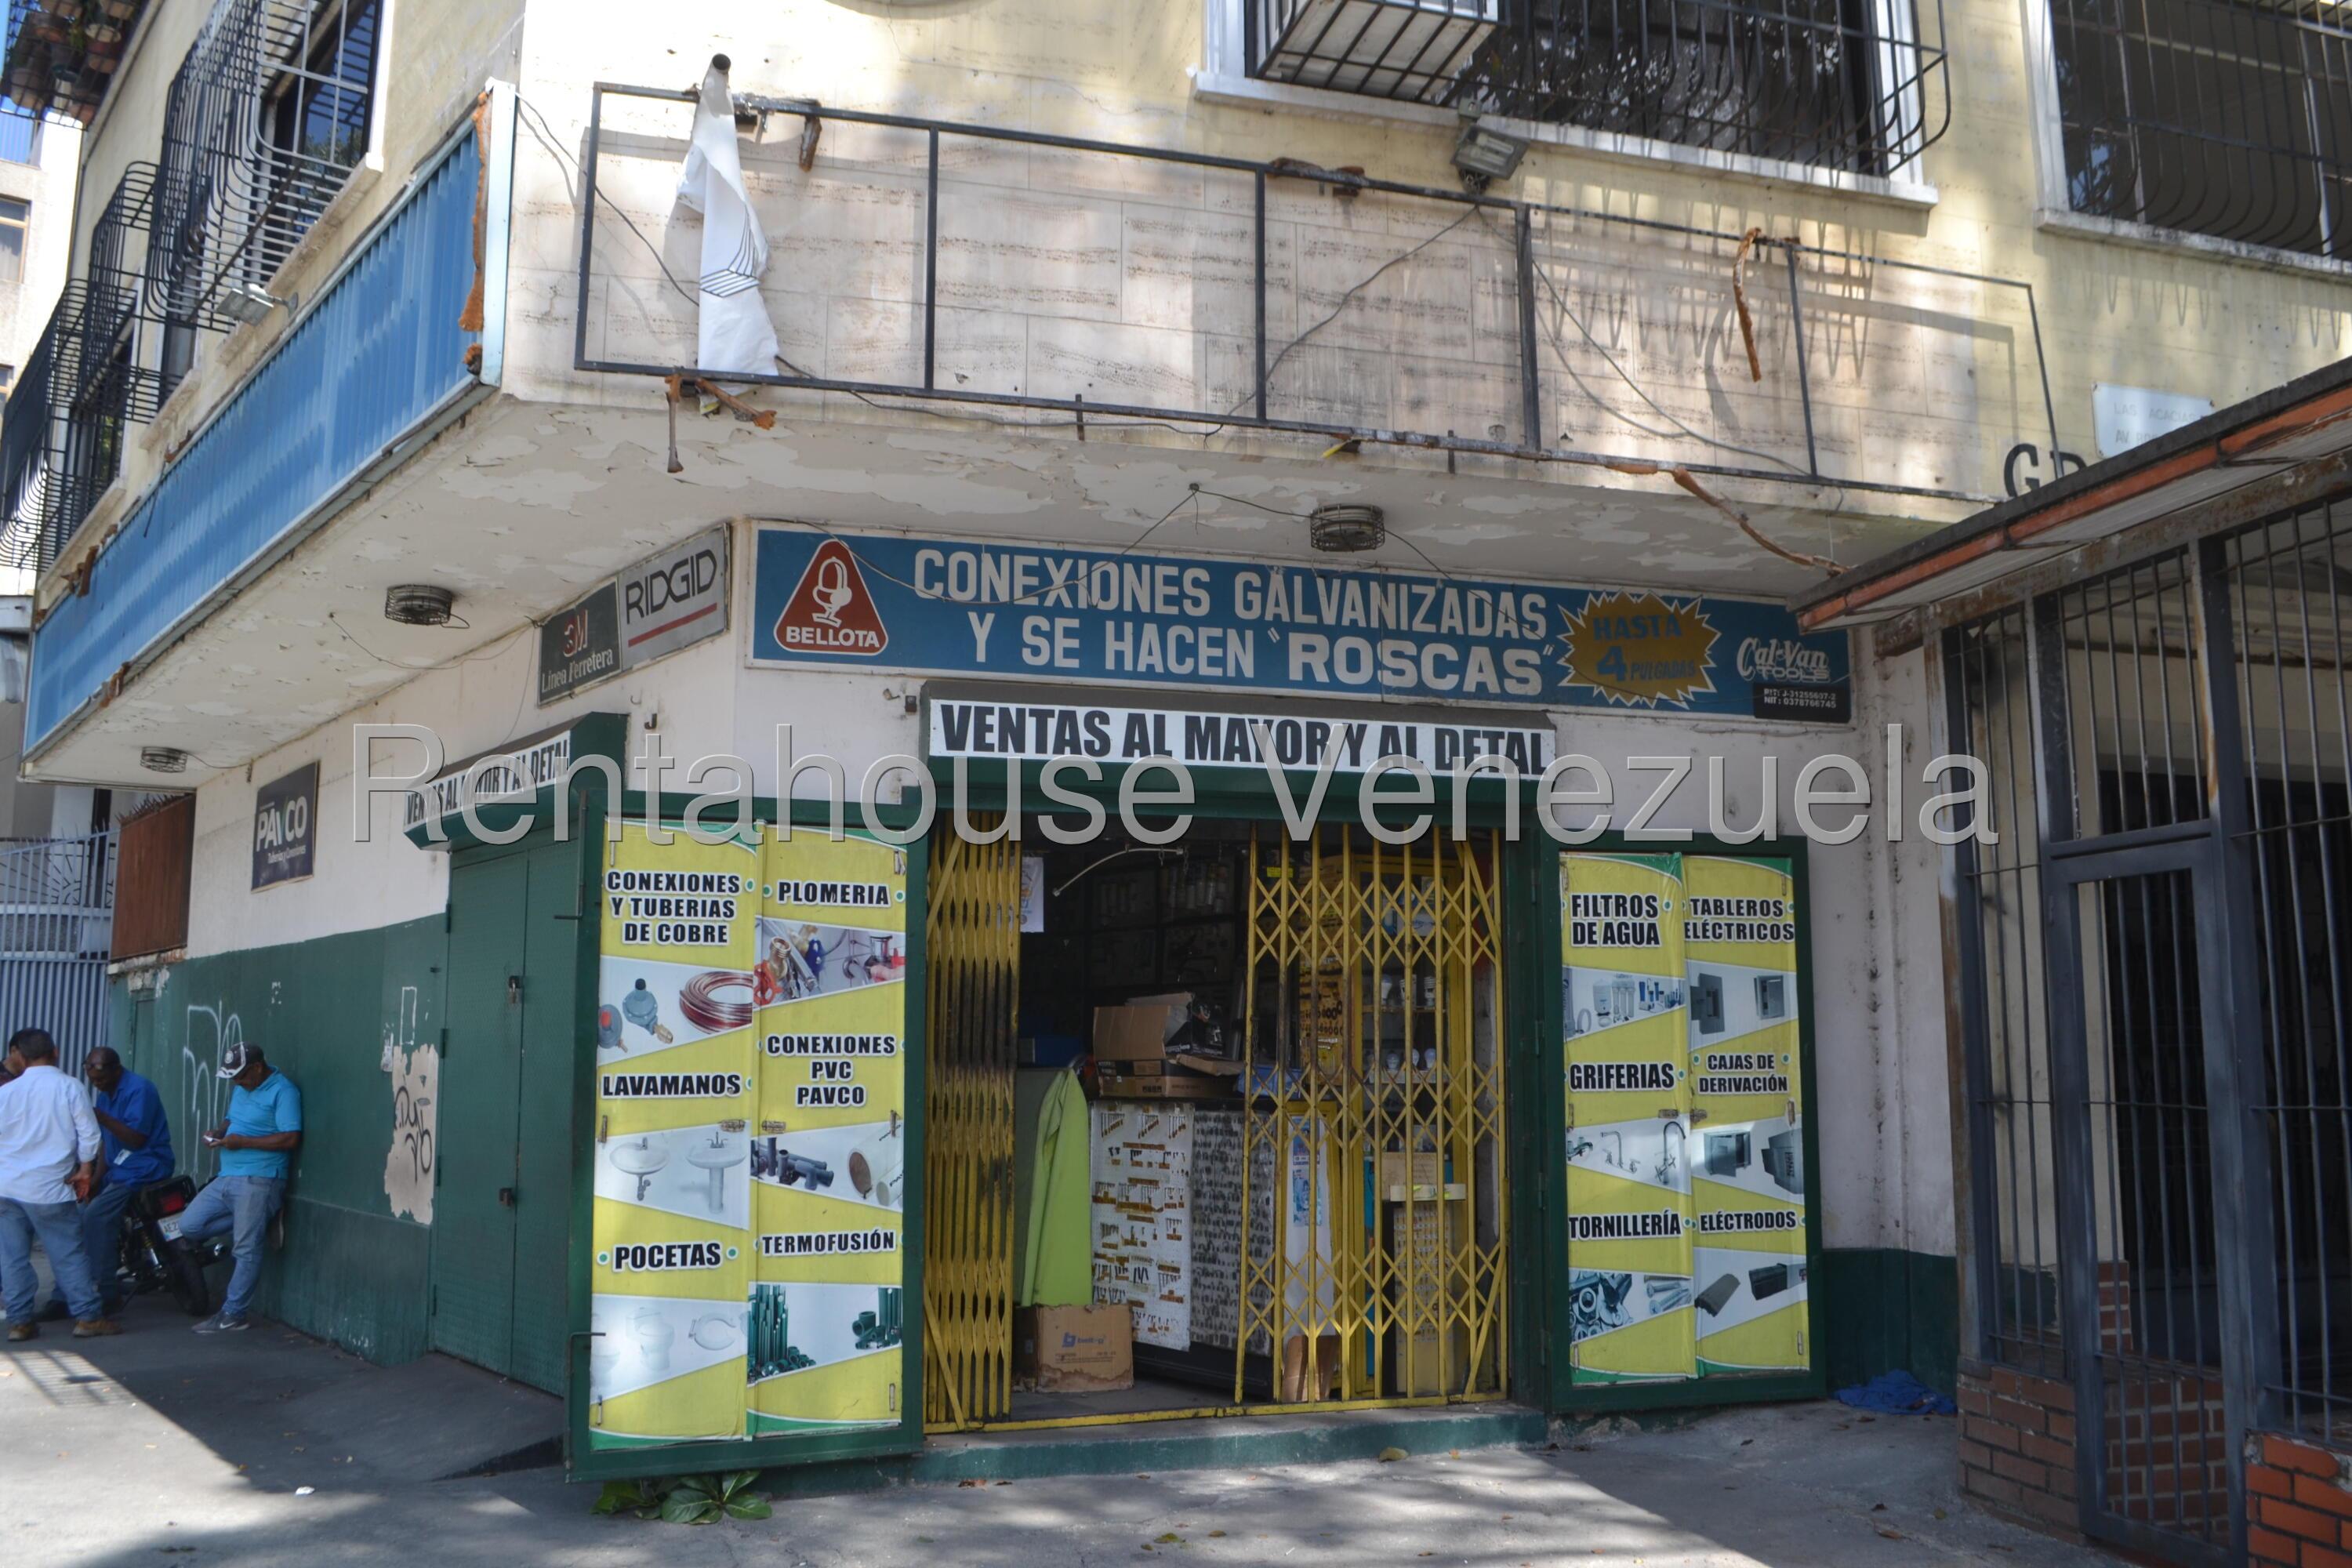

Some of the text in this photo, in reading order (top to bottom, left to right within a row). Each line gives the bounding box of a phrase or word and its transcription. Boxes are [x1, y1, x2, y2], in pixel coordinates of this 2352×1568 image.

[626, 549, 717, 625] RIDGID
[914, 549, 1548, 640] CONEXIONES GALVANIZADAS
[786, 625, 880, 649] BELLOTA
[1592, 614, 1682, 641] HASTA
[967, 612, 995, 662] Y
[1022, 615, 1080, 669] SE
[1105, 621, 1254, 678] HACEN
[568, 648, 613, 683] Ferretera
[1596, 645, 1696, 682] 4 PULGADAS
[1756, 666, 1831, 683] TOOLS
[940, 704, 1548, 775] VENTAS AL MAYOR Y AL DETAL
[445, 778, 457, 811] AL
[530, 739, 568, 785] DETAL
[256, 796, 307, 852] PAVCO
[608, 872, 740, 893] CONEXIONES
[779, 882, 889, 905] PLOMERIA
[612, 898, 735, 918] Y TUBERIAS
[1571, 895, 1658, 917] FILTROS
[1690, 898, 1783, 916] TABLEROS
[625, 923, 728, 943] DE COBRE
[1573, 921, 1660, 945] DE AGUA
[1684, 919, 1795, 940] ELÉCTRICOS
[767, 1035, 895, 1054] CONEXIONES
[811, 1061, 851, 1080] PVC
[1708, 1054, 1774, 1069] CAJAS DE
[603, 1074, 741, 1096] LAVAMANOS
[1570, 1063, 1675, 1089] GRIFERIAS
[1699, 1074, 1788, 1092] DERIVACIÓN
[797, 1087, 865, 1105] PAVCO
[1569, 1209, 1682, 1239] TORNILLERÍA
[1700, 1211, 1796, 1231] ELÉCTRODOS
[762, 1229, 895, 1254] TERMOFUSIÓN
[615, 1243, 721, 1270] POCETAS
